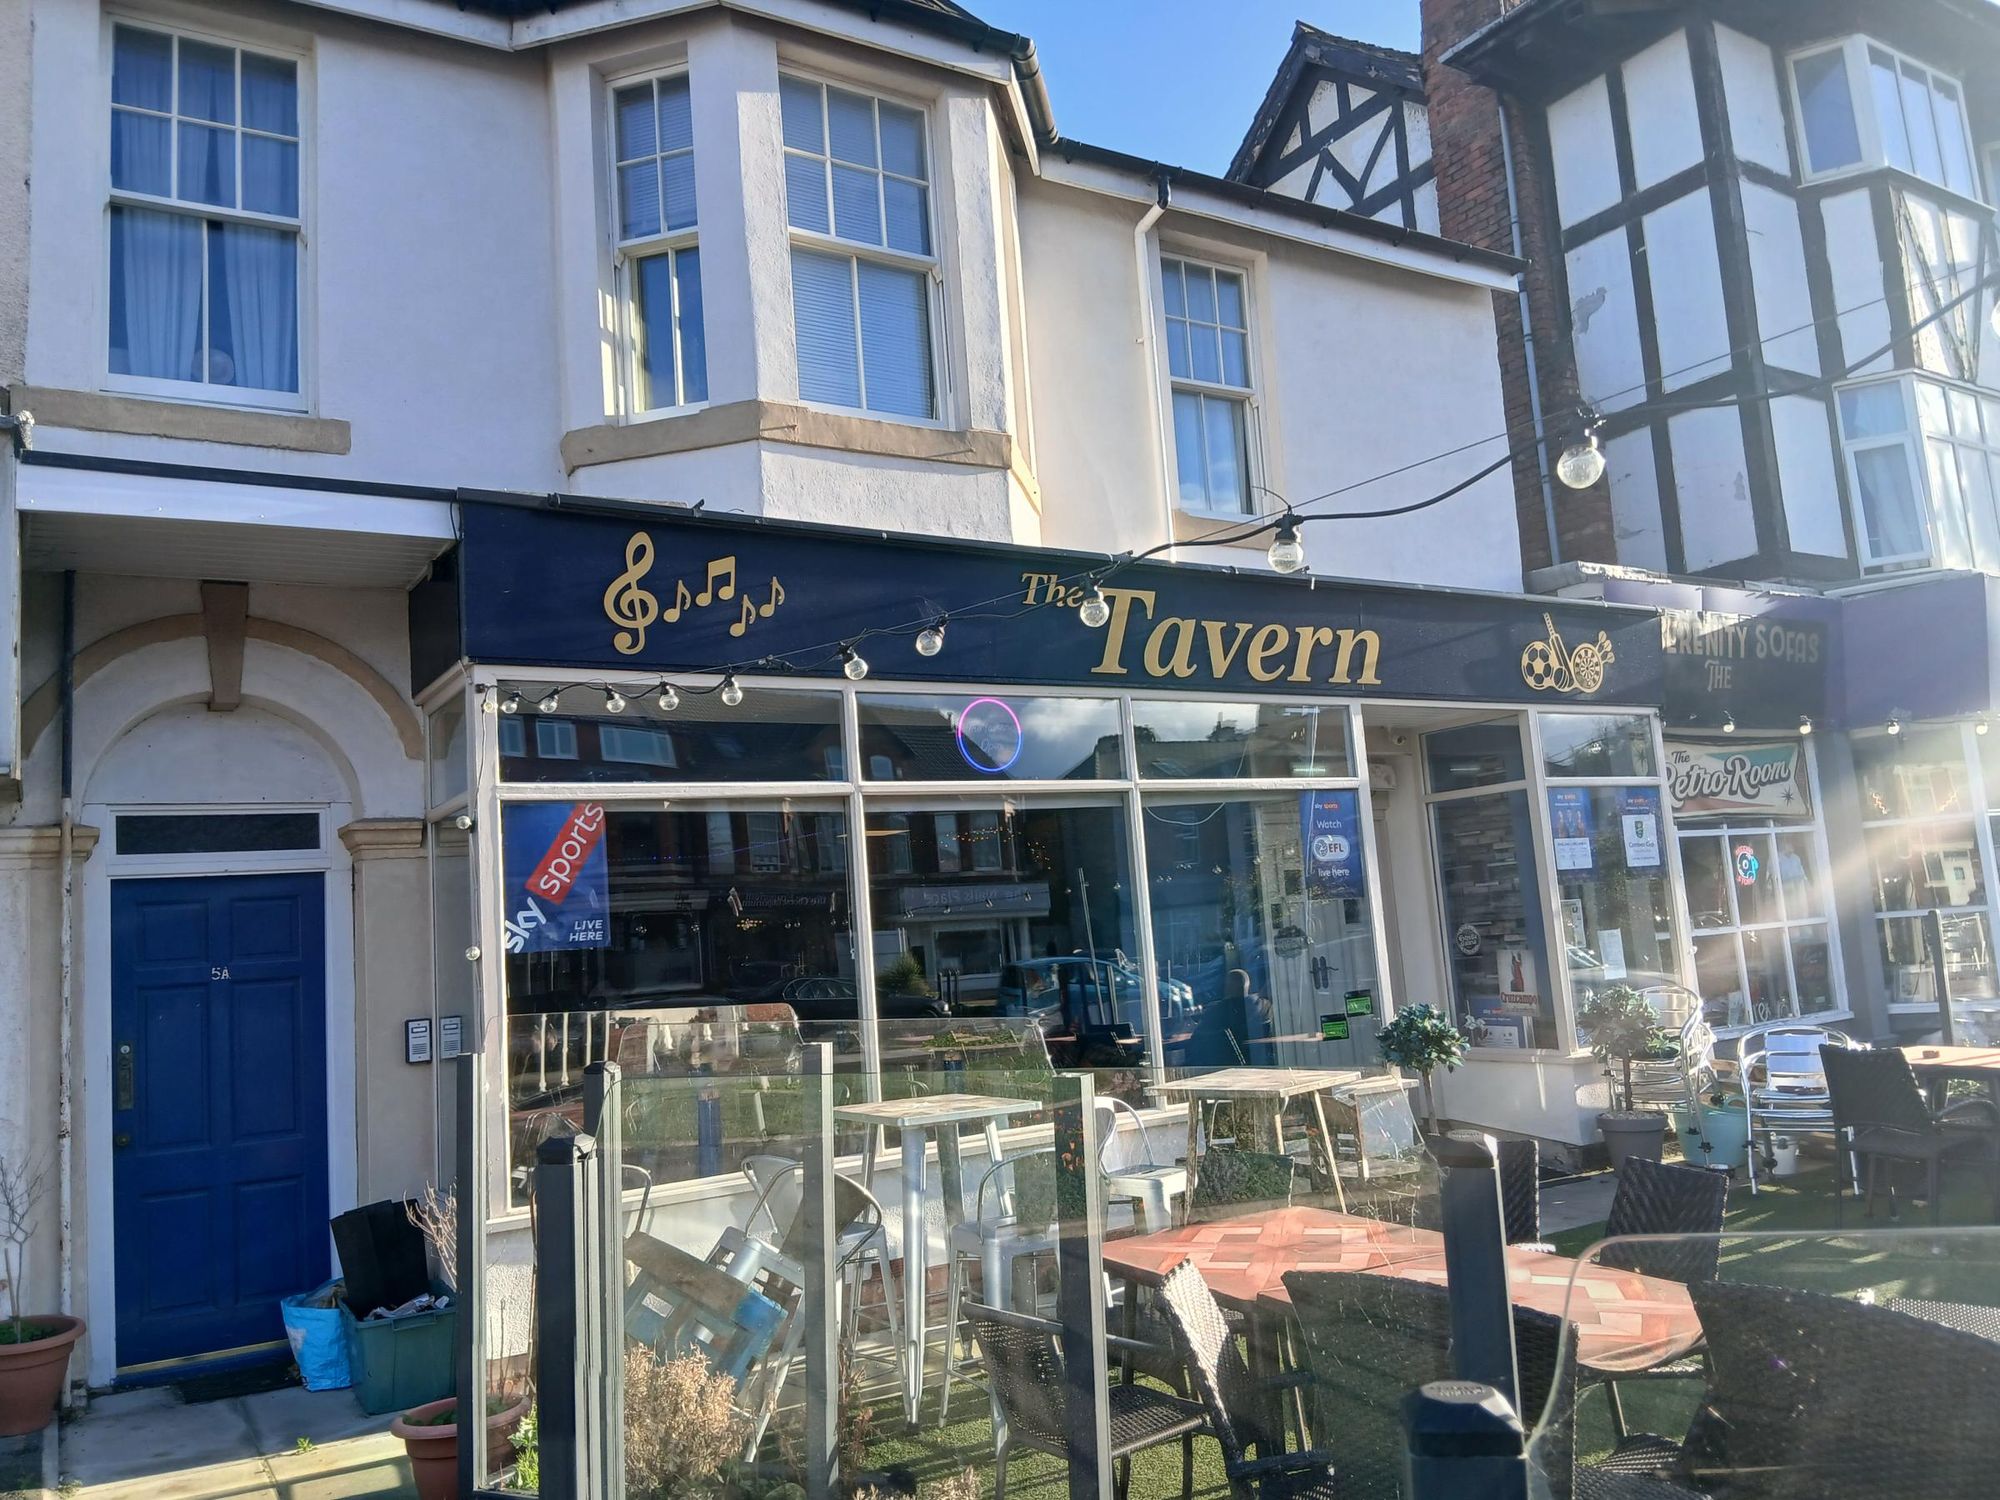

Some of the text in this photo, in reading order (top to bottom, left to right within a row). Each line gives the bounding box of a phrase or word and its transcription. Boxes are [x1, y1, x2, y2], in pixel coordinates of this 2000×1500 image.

[1020, 572, 1084, 607] The
[1091, 587, 1383, 686] Tavern
[1755, 624, 1820, 664] SOFAS
[1704, 659, 1733, 692] THE
[1671, 750, 1690, 765] The
[1723, 753, 1792, 800] Room
[1316, 819, 1342, 829] Watch
[539, 802, 604, 895] sports
[1328, 843, 1344, 853] EFL
[1318, 866, 1350, 877] live here
[504, 896, 547, 954] sky
[569, 930, 604, 942] HERE
[574, 919, 604, 931] LIVE
[211, 966, 232, 981] 5A
